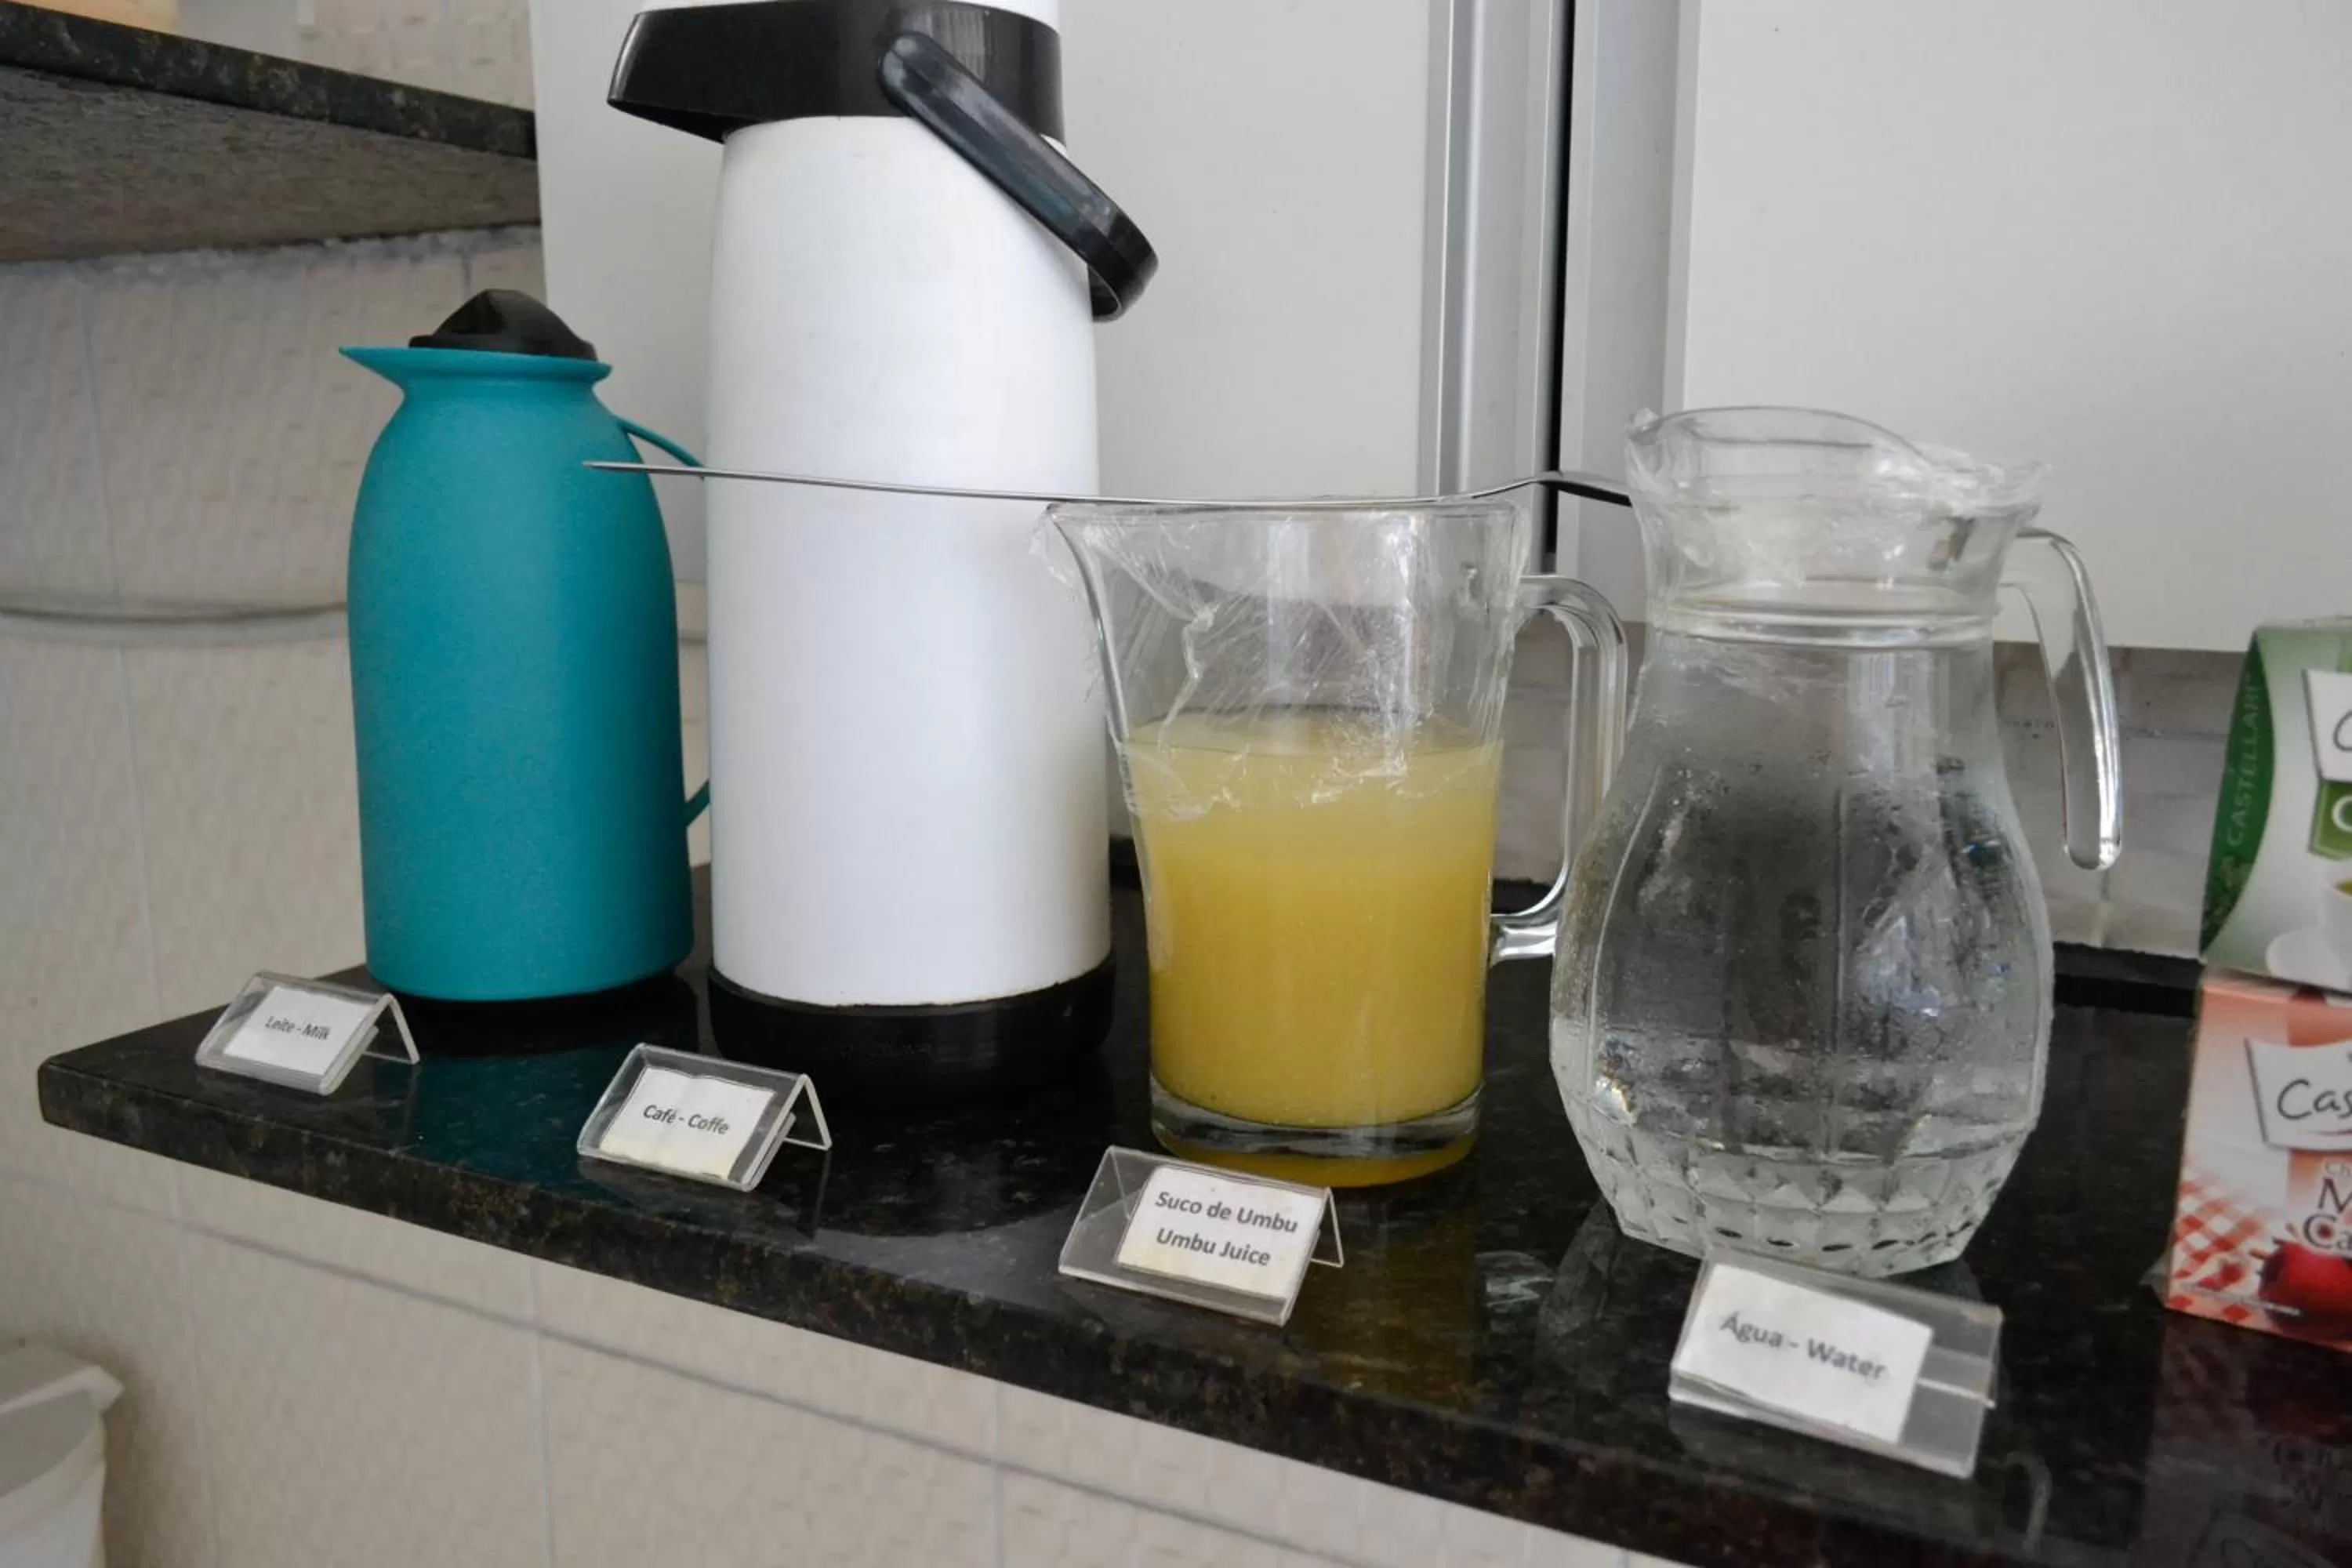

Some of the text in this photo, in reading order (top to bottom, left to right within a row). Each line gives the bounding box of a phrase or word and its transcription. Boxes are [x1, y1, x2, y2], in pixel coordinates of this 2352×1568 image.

[643, 1105, 677, 1123] Café
[688, 1114, 729, 1134] Coffe
[1155, 1192, 1298, 1232] Suco de Umbu
[1156, 1228, 1271, 1266] Umbu Juice
[1719, 1312, 1784, 1348] Água
[1807, 1338, 1886, 1379] Water
